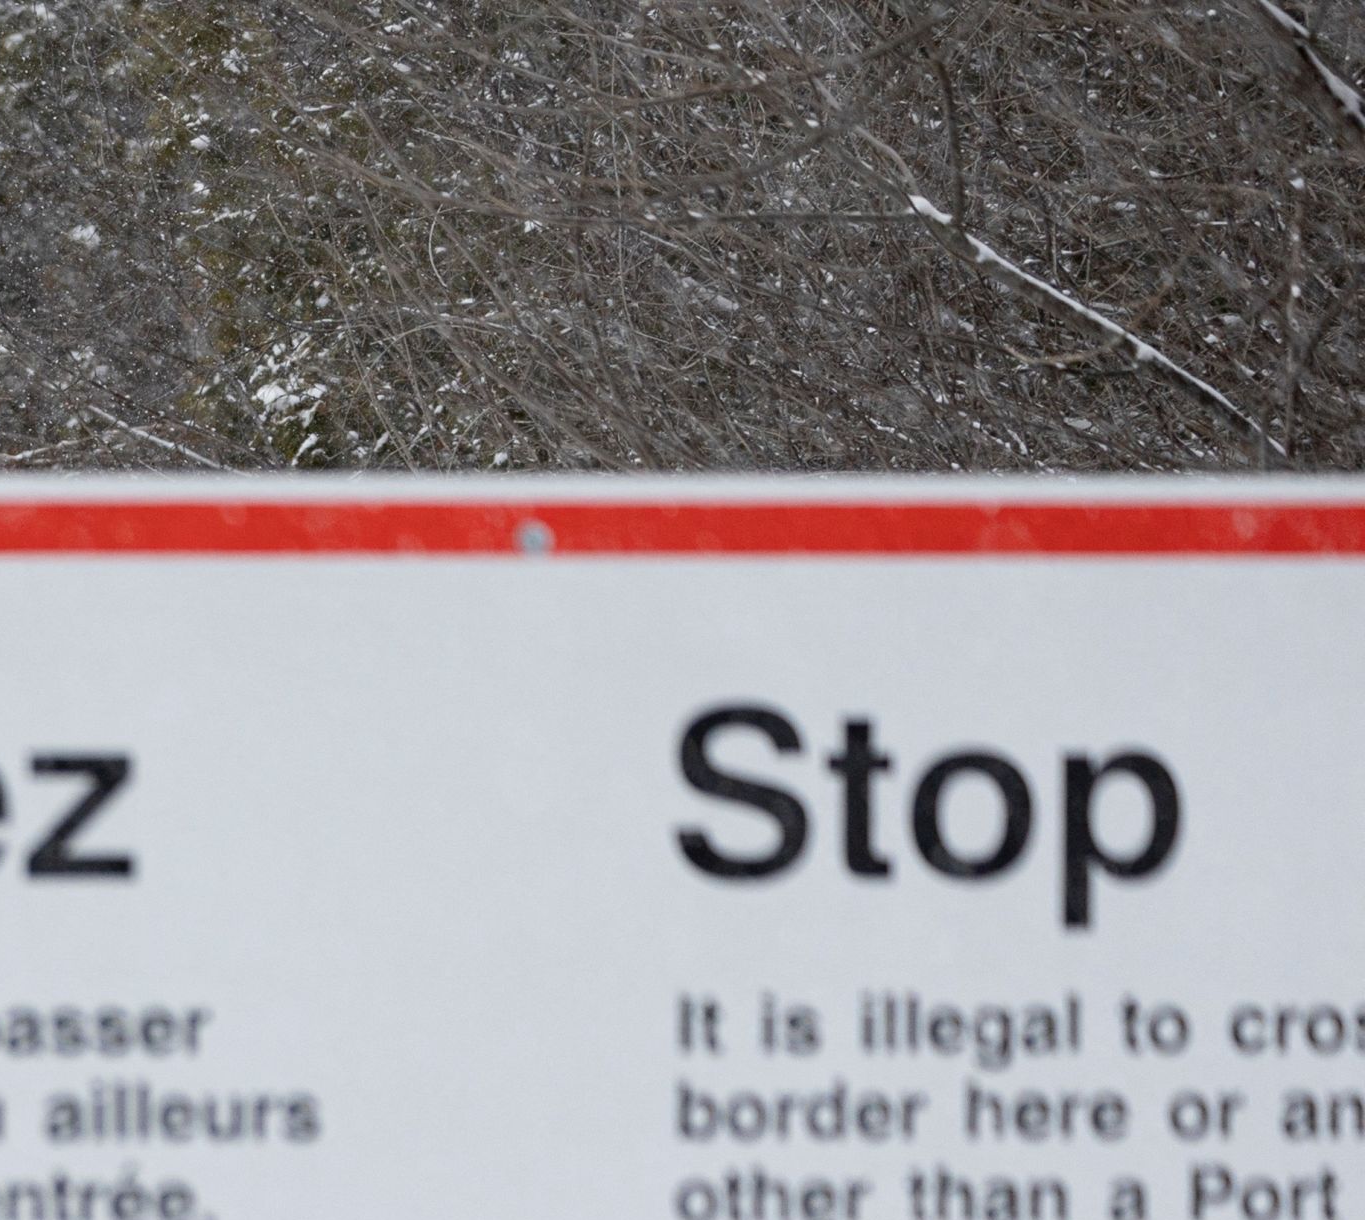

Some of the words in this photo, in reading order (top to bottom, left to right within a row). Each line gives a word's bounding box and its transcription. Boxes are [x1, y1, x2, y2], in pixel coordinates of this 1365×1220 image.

[671, 698, 1187, 936] Stop
[675, 993, 724, 1056] It
[759, 993, 824, 1056] is
[859, 991, 1084, 1070] illegal
[1117, 995, 1194, 1057] to
[1225, 1002, 1365, 1056] cro
[43, 1083, 321, 1144] ailleurs
[674, 1080, 927, 1143] border
[963, 1079, 1132, 1143] here
[1165, 1090, 1247, 1143] or
[1278, 1090, 1365, 1143] an
